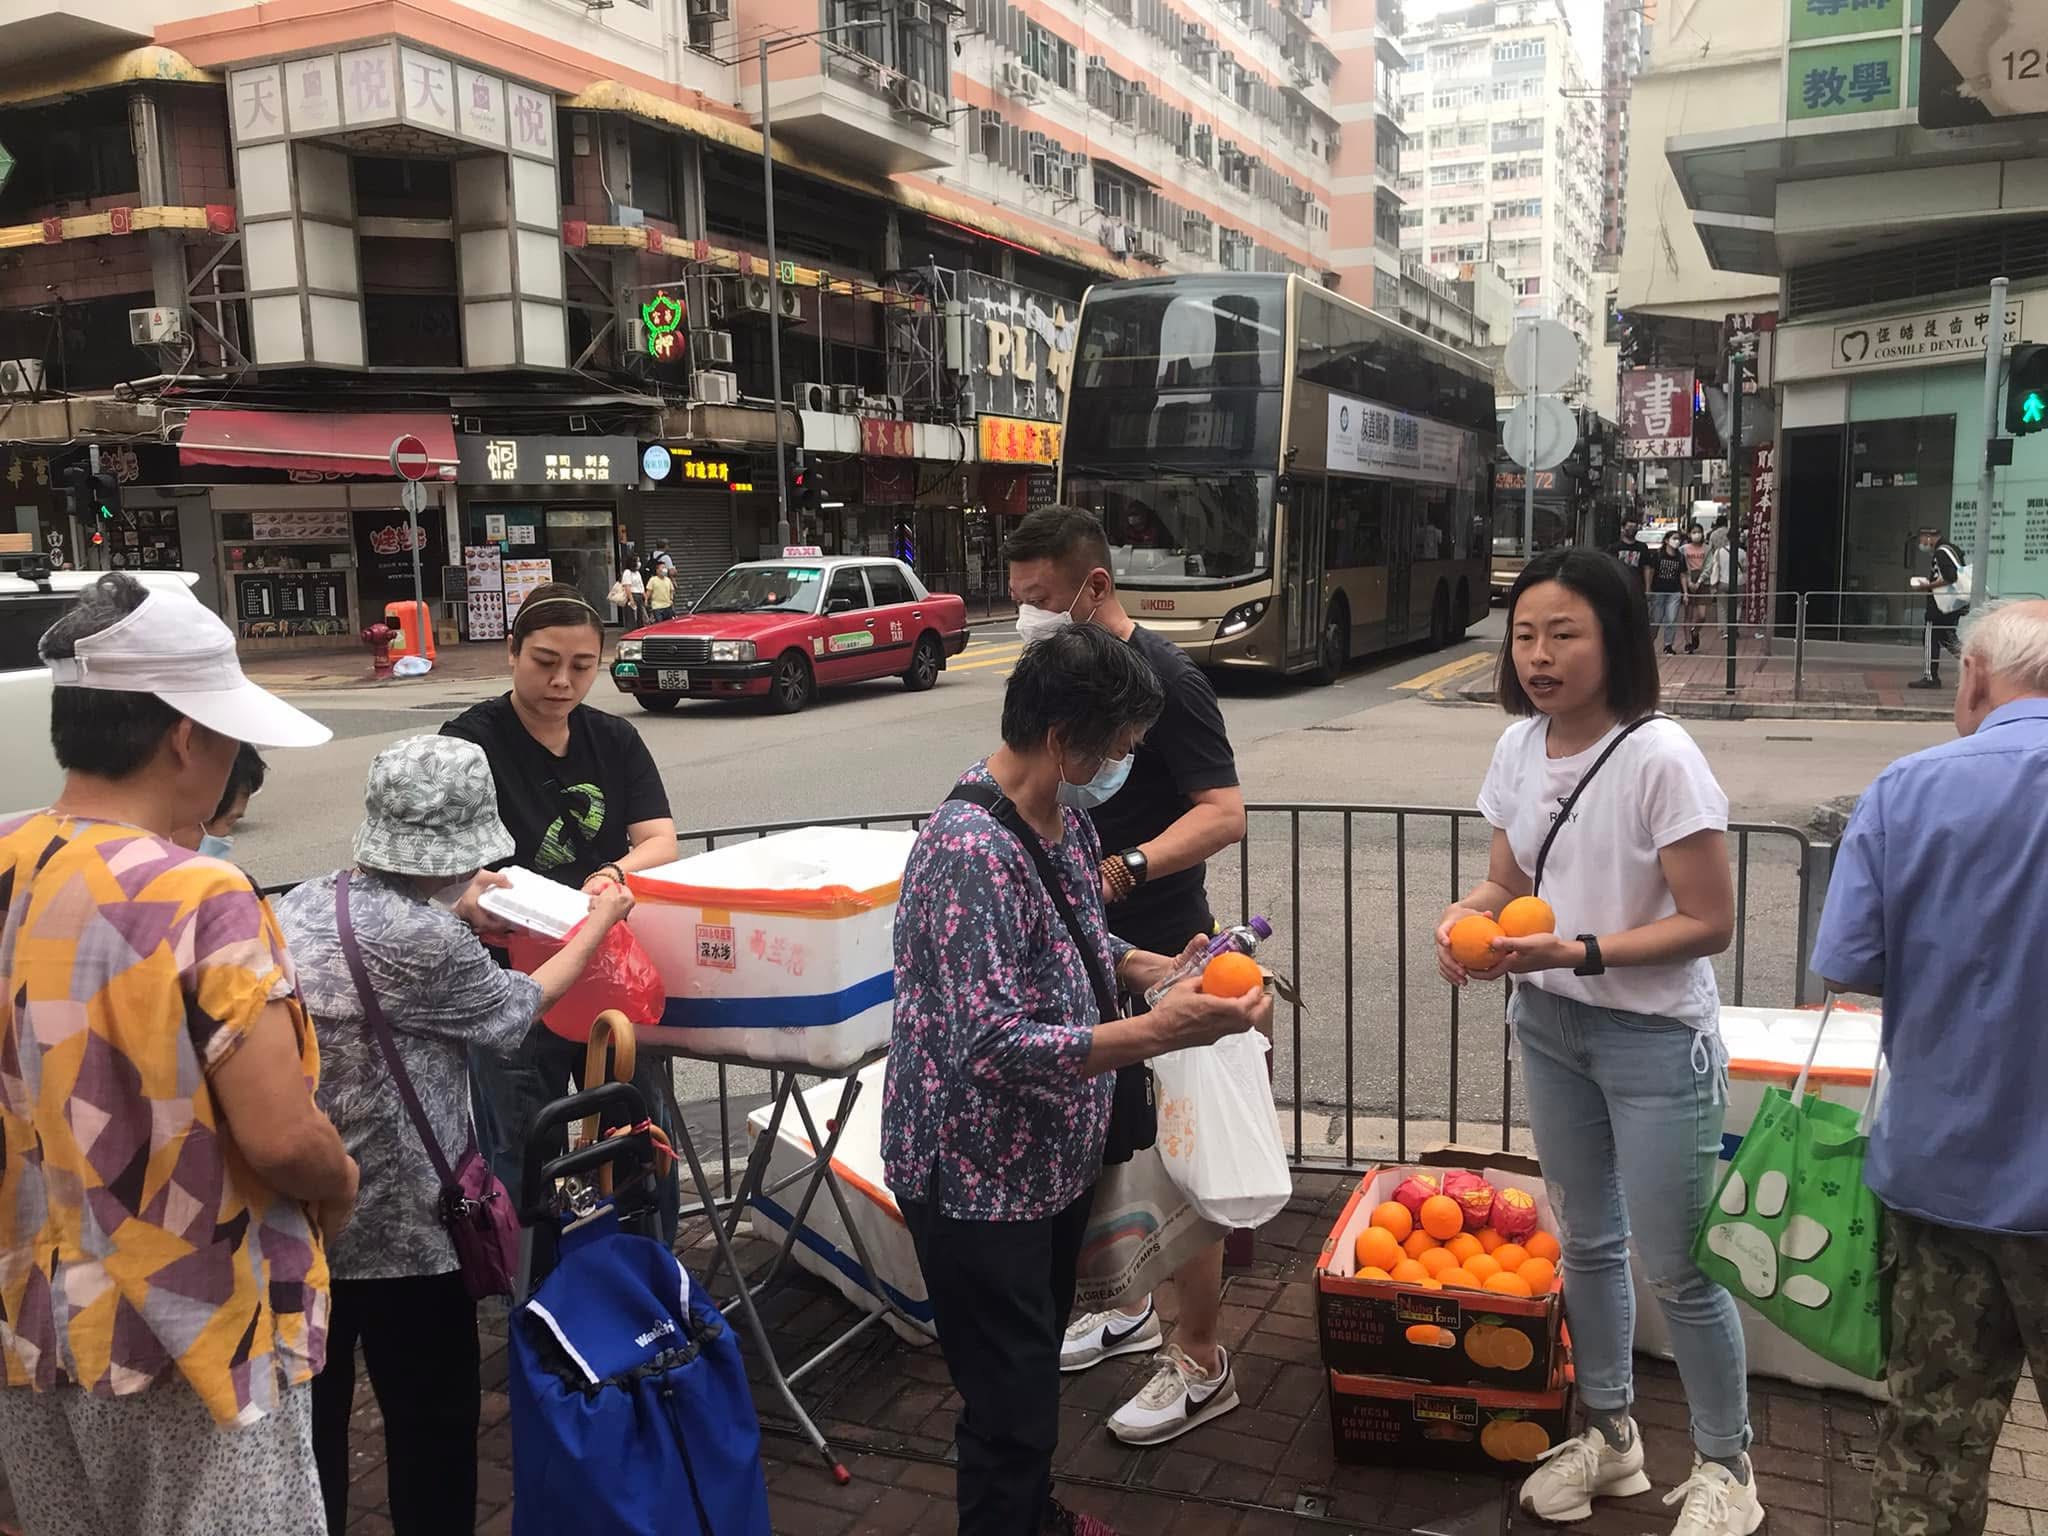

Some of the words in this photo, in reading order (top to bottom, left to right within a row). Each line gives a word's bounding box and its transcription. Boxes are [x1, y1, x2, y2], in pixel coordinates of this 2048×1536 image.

[240, 75, 277, 128] 天
[407, 60, 446, 116] 天
[1803, 61, 1891, 110] 教學
[1874, 343, 1928, 360] COSMILE
[1930, 336, 1978, 352] DENTAL
[1633, 373, 1682, 437] 書
[1535, 472, 1553, 489] 72
[786, 548, 816, 557] TAXI
[1132, 1242, 1161, 1275] TEMPS
[1434, 1305, 1457, 1324] farm
